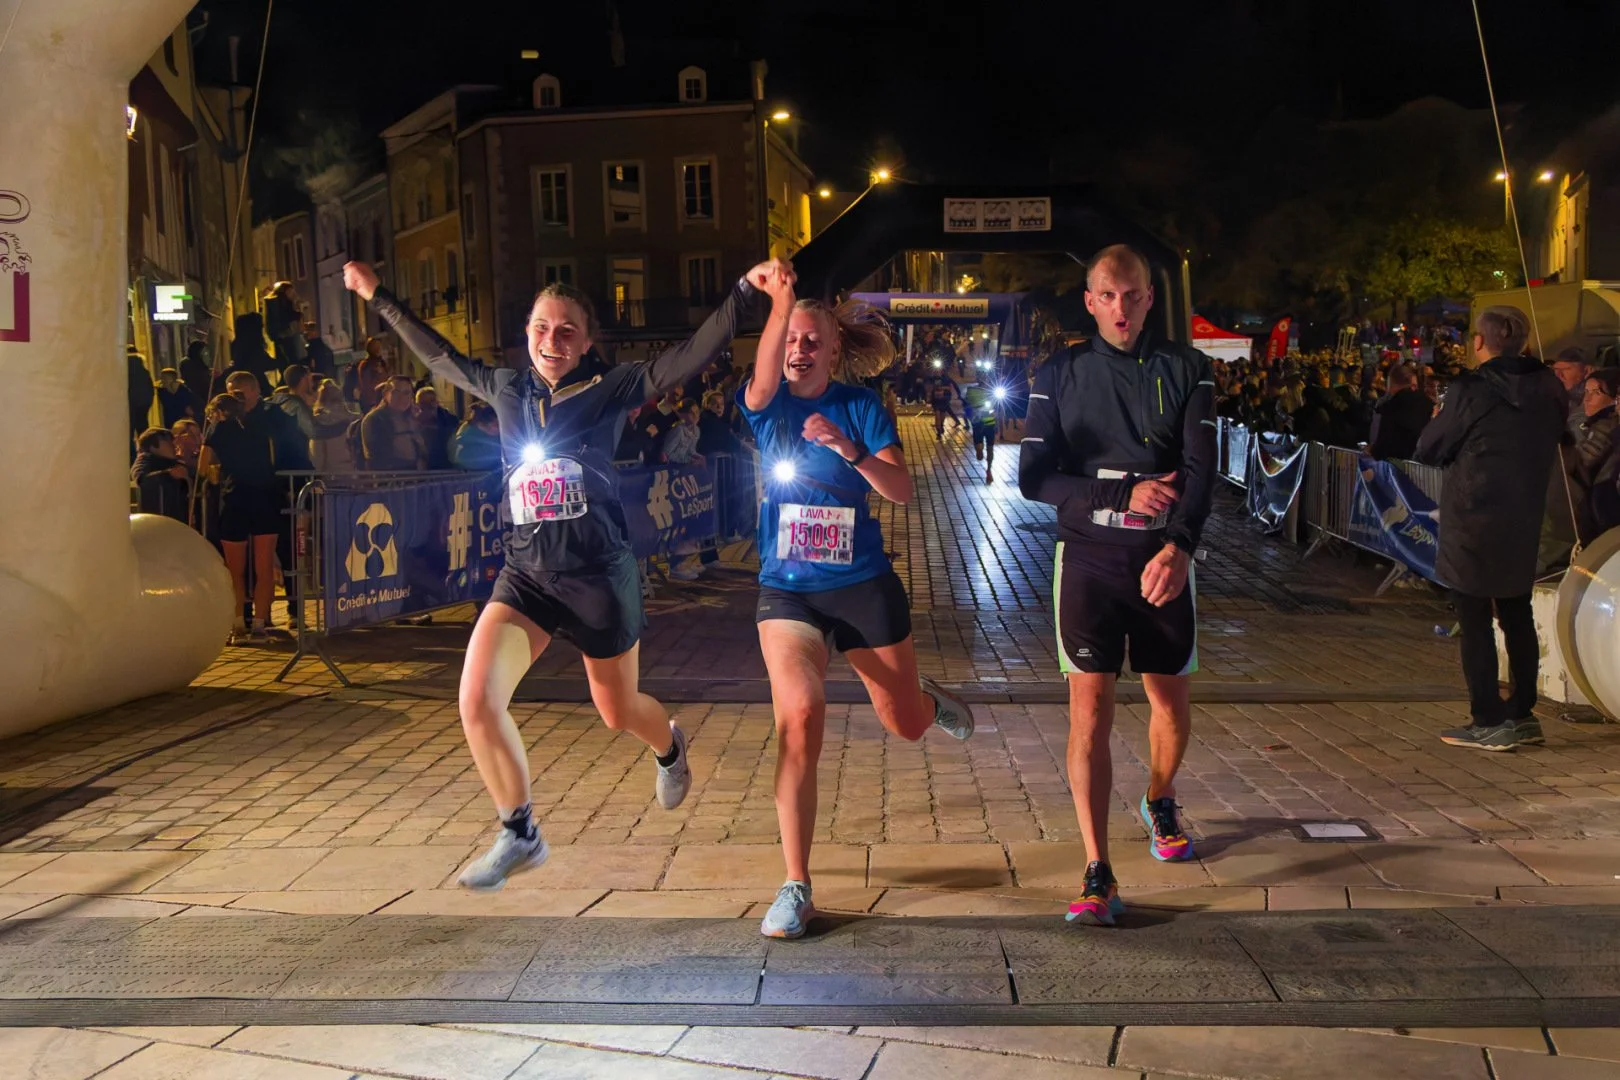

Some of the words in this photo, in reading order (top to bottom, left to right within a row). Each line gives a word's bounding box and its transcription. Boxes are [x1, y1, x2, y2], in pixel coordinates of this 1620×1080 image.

[896, 303, 929, 313] Crédit
[944, 304, 983, 313] Mutuel
[519, 477, 566, 507] 1627
[790, 521, 838, 549] 1509
[378, 585, 411, 602] Mutuel
